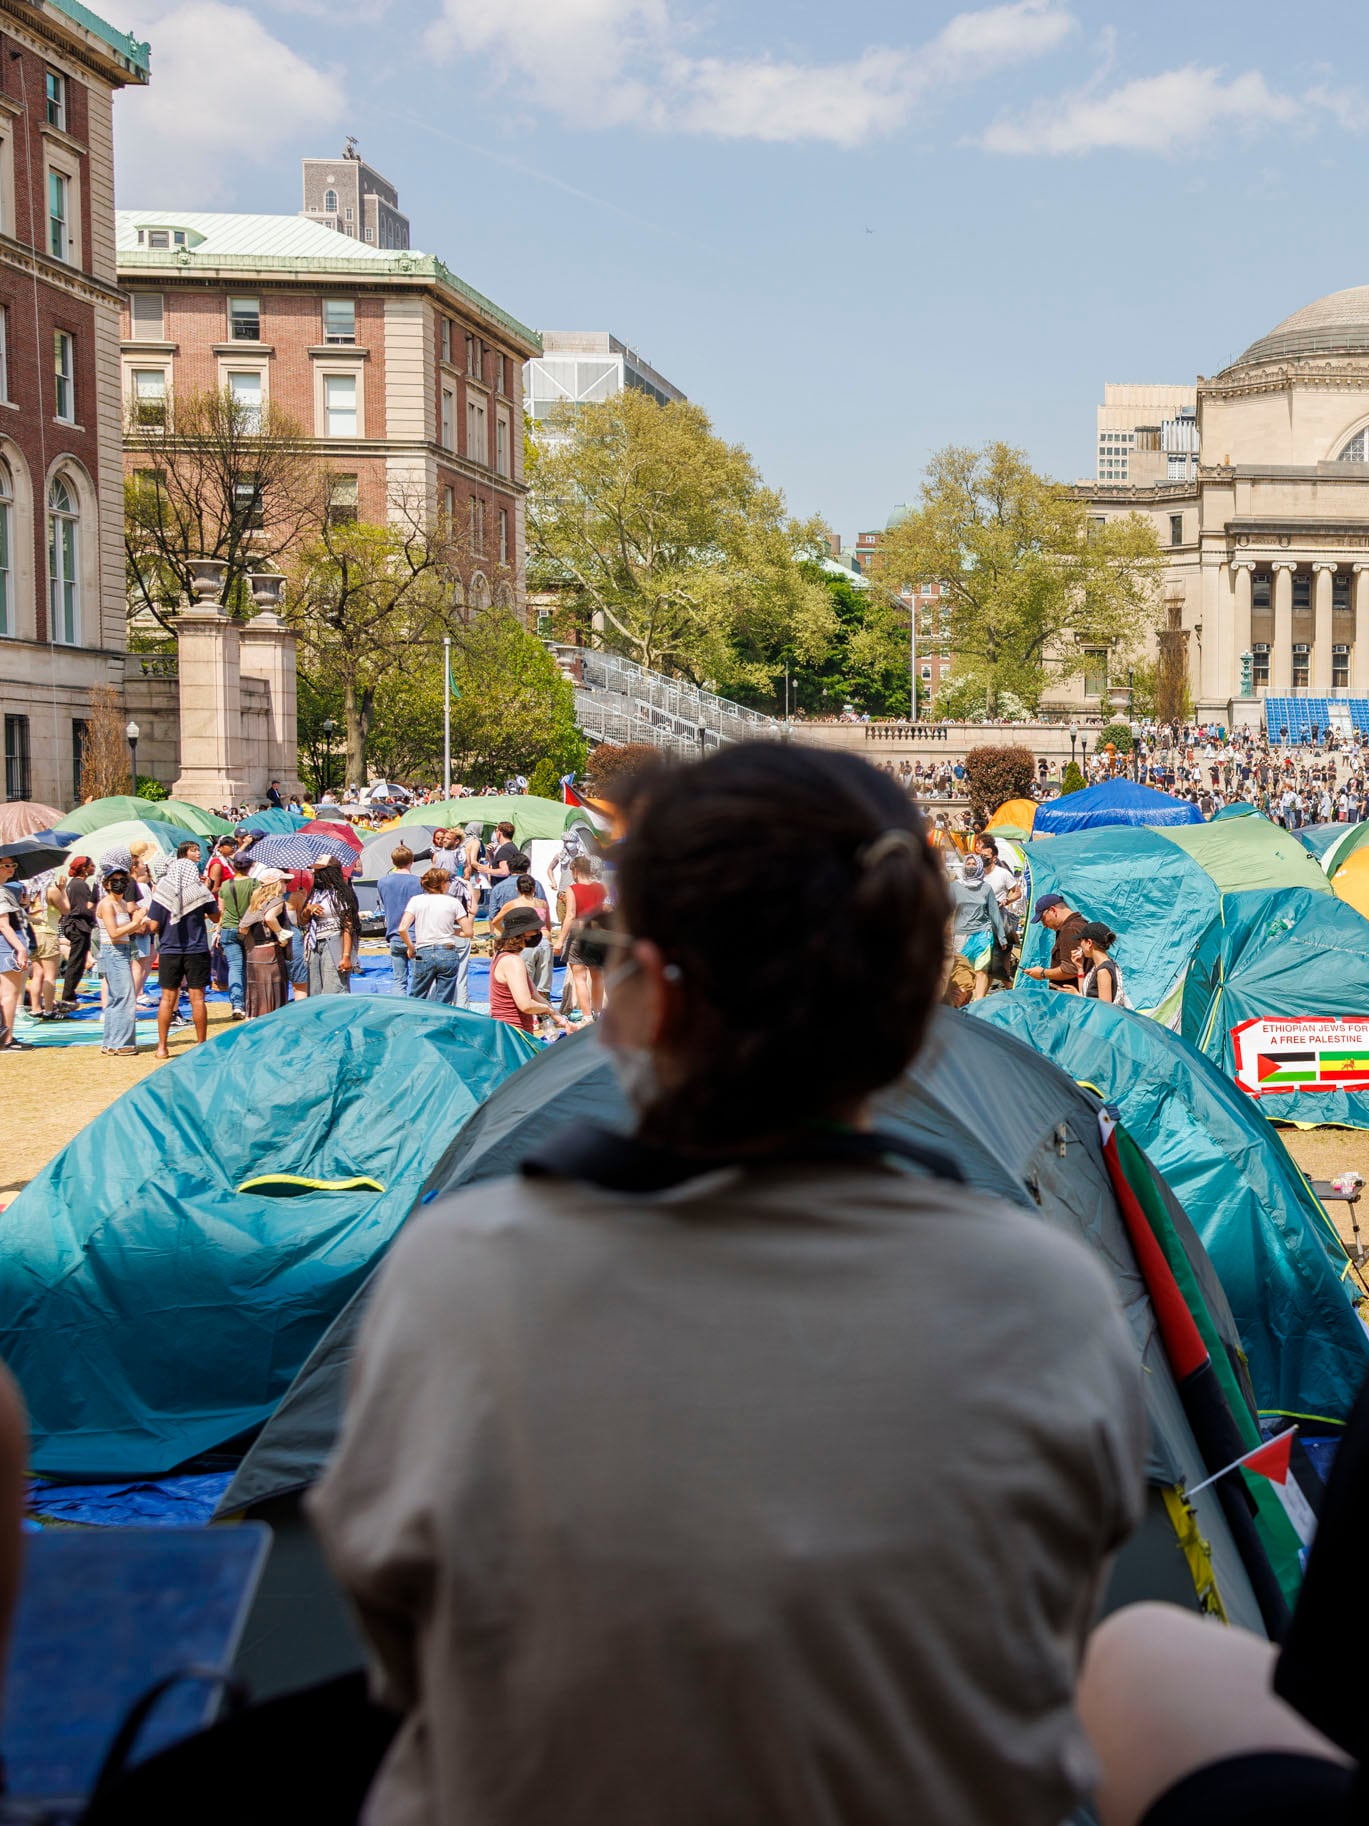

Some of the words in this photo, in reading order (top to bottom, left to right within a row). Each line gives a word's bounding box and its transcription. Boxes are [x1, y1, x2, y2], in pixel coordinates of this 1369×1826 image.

[1262, 1024, 1316, 1033] ETHIOPIAN
[1318, 1024, 1346, 1033] JEWS
[1348, 1024, 1368, 1033] FOR
[1270, 1037, 1278, 1045] A
[1280, 1036, 1306, 1045] FREE
[1308, 1035, 1363, 1044] PALESTINE
